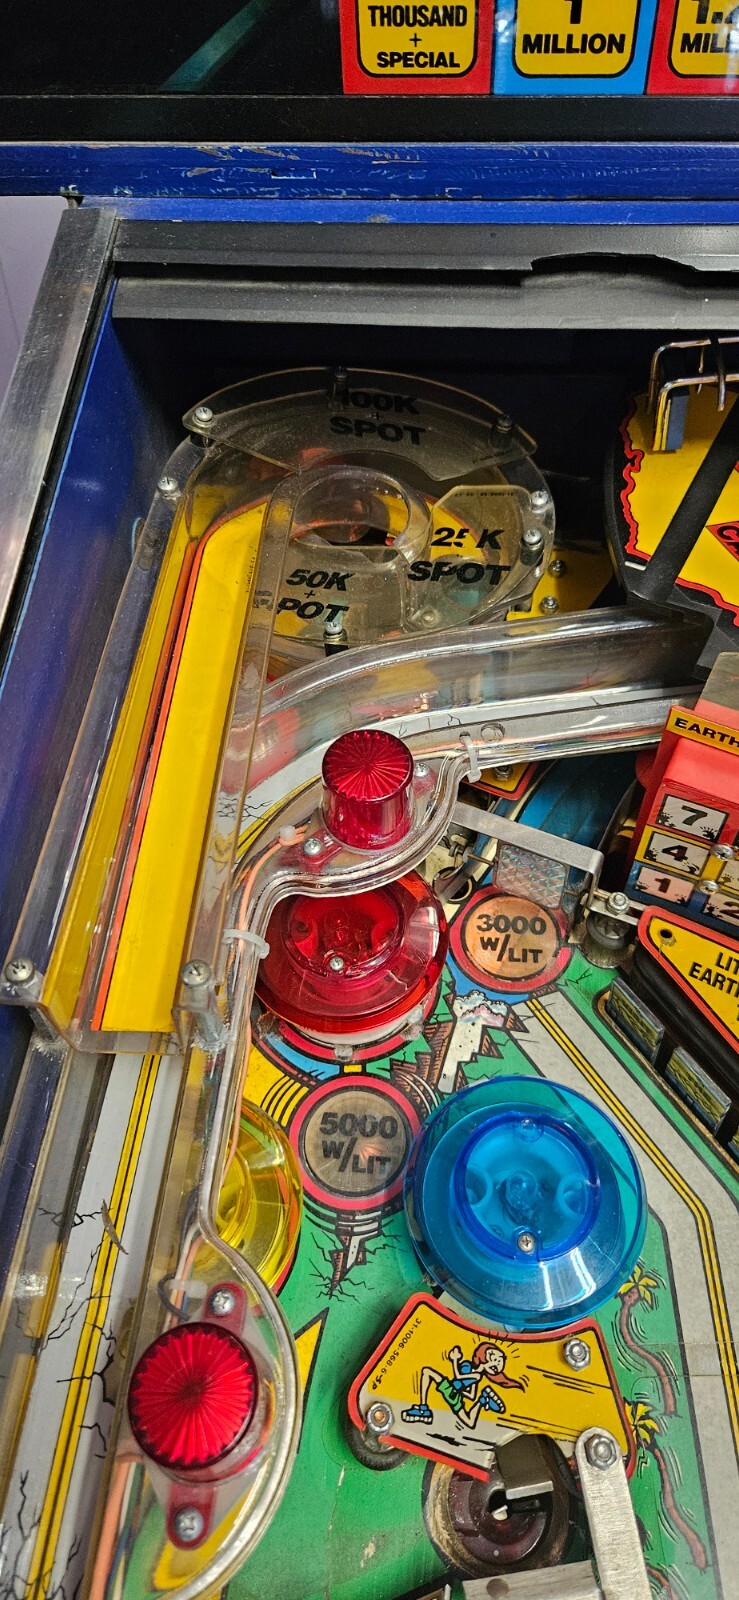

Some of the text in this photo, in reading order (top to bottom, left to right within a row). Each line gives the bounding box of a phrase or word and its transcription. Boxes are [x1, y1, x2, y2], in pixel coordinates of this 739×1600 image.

[368, 5, 467, 27] THOUSAND
[522, 34, 625, 54] MILLION
[377, 51, 460, 68] SPECIAL
[330, 416, 426, 445] SPOT
[286, 569, 355, 591] 50K
[408, 561, 511, 585] SPOT
[276, 598, 349, 623] POT
[681, 805, 708, 826] 7
[661, 845, 688, 862] 4
[655, 878, 671, 893] 1
[477, 914, 547, 935] 3000
[480, 934, 543, 963] W/LIT
[319, 1112, 398, 1139] 5000
[322, 1137, 391, 1174] W/LIT
